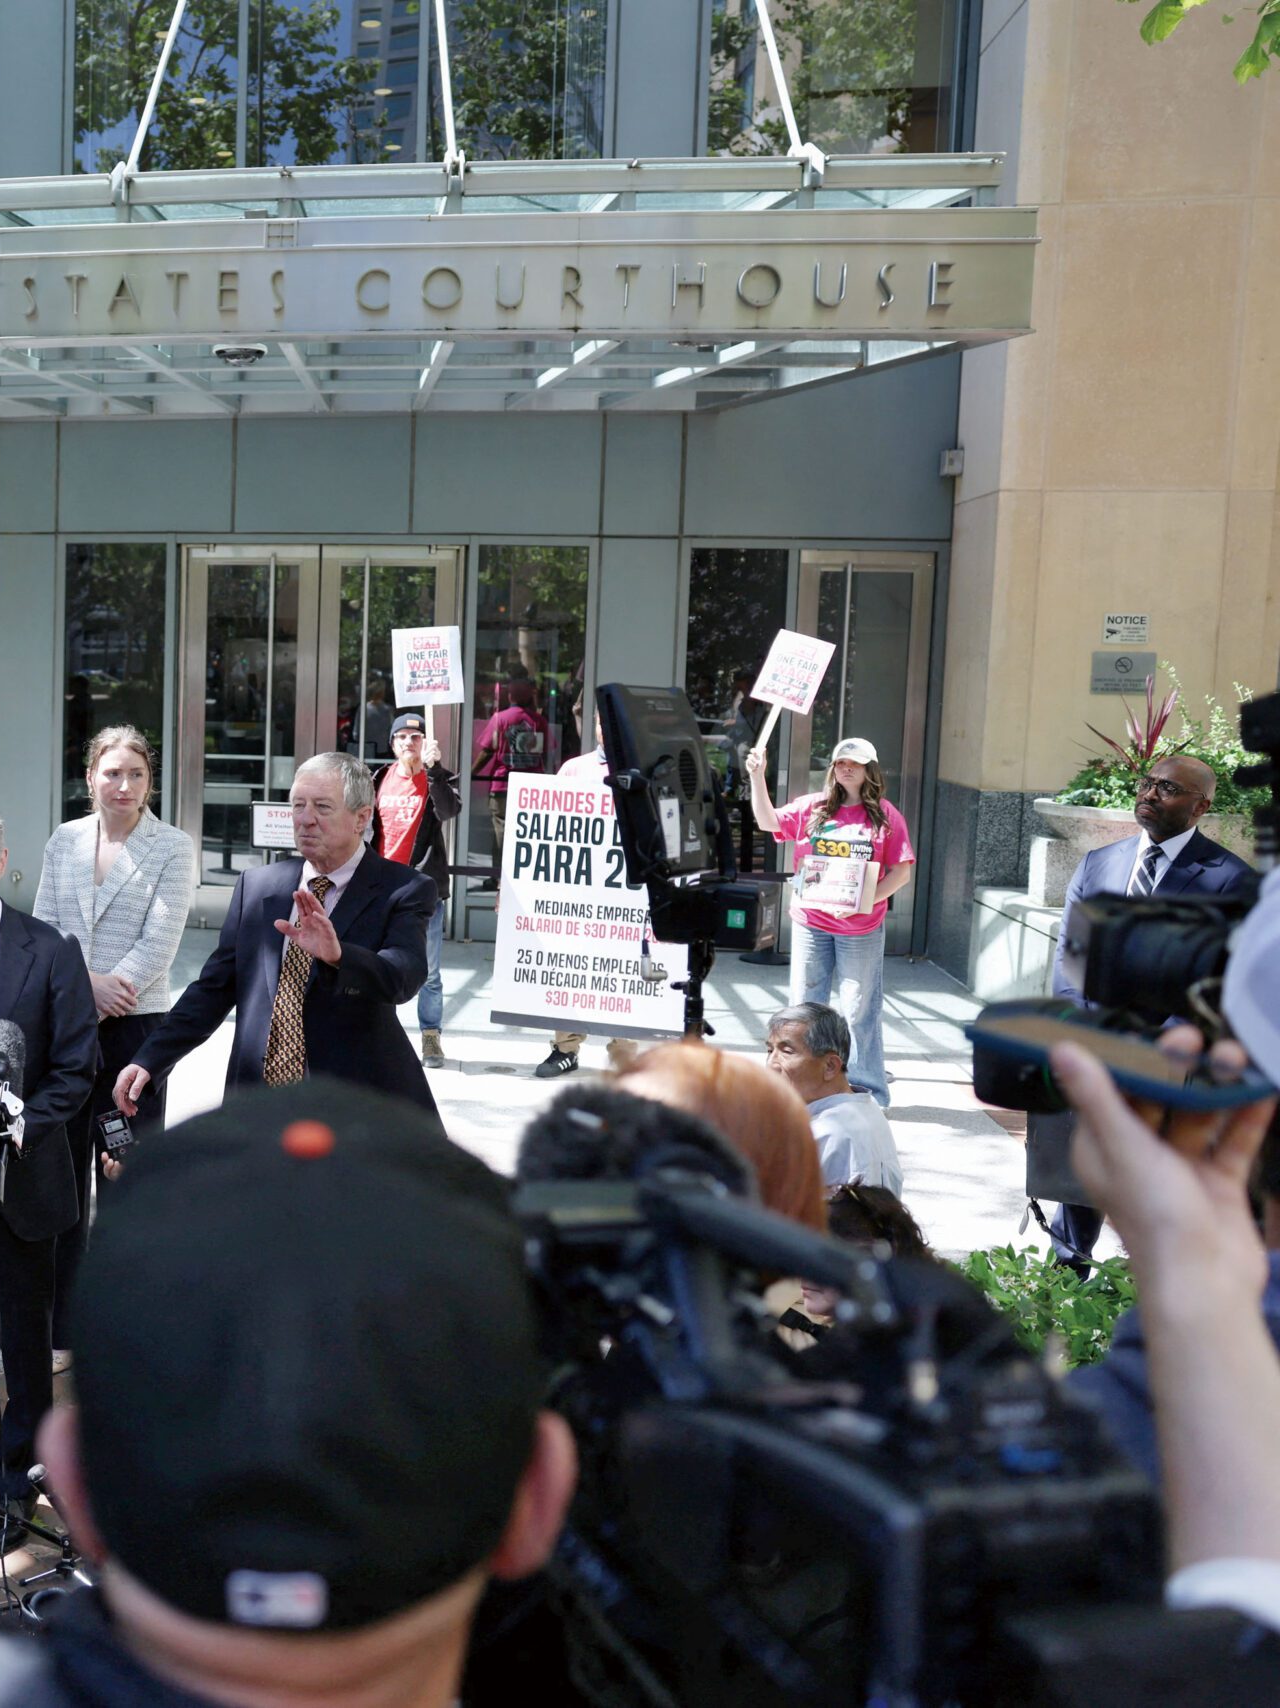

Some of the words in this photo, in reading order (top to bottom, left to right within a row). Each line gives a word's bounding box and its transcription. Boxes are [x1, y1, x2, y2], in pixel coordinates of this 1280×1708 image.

[23, 269, 286, 318] STATES
[355, 261, 956, 310] COURTHOUSE
[1107, 615, 1147, 624] NOTICE
[406, 651, 425, 661] ONE
[428, 649, 448, 659] FAIR
[408, 658, 449, 671] WAGE
[797, 659, 819, 673] FAIR
[380, 795, 422, 809] STOP
[518, 787, 594, 815] GRANDES
[267, 810, 293, 819] STOP
[516, 811, 605, 846] SALARIO
[816, 840, 850, 858] $30
[513, 841, 592, 887] PARA
[534, 899, 593, 919] MEDIANAS
[596, 905, 651, 925] EMPRESA
[515, 916, 562, 935] SALARIO
[565, 921, 580, 936] DE
[583, 922, 607, 940] $30
[610, 925, 640, 942] PARA
[516, 948, 532, 965] 25
[547, 952, 589, 971] MENOS
[513, 967, 537, 984] UNA
[540, 967, 588, 990] DÉCADA
[590, 973, 618, 993] MÁS
[621, 978, 665, 998] TARDE:
[545, 990, 569, 1008] $30
[571, 993, 596, 1011] POR
[599, 994, 632, 1014] HORA
